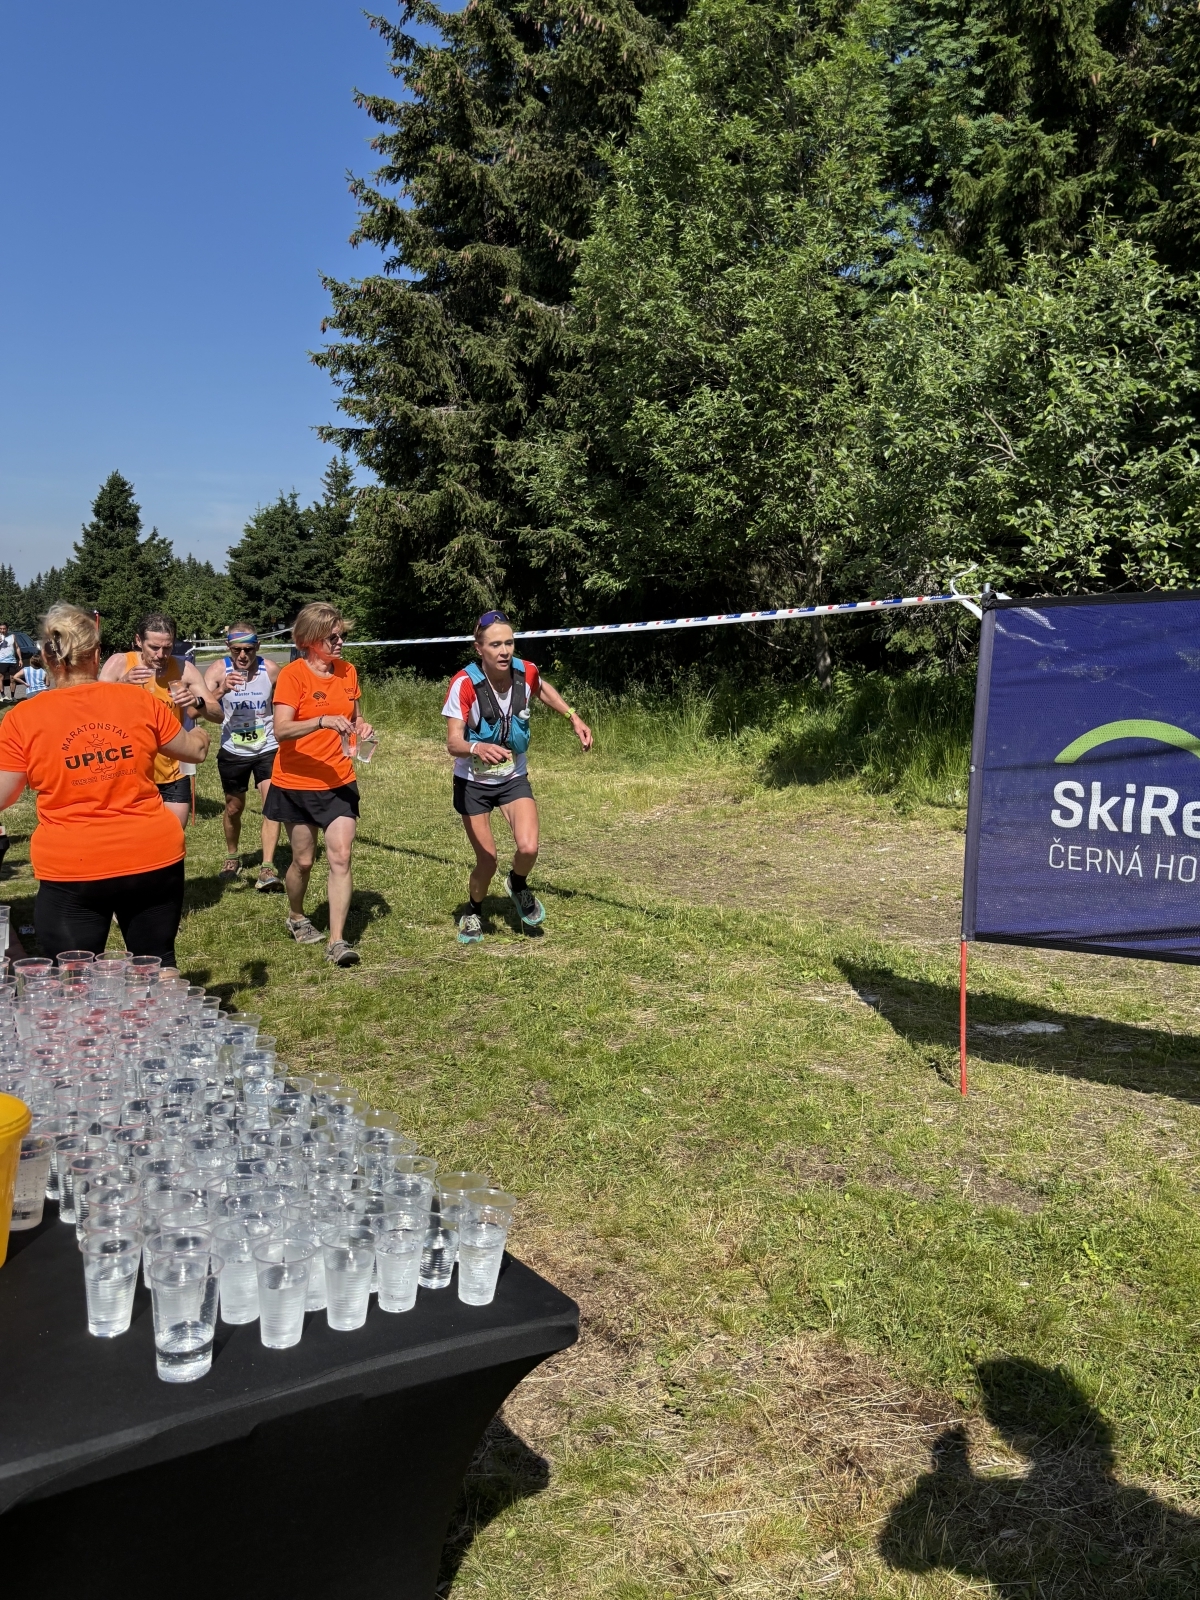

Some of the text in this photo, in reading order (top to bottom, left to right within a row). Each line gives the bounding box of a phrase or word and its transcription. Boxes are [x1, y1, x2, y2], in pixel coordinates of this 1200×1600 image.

[230, 700, 267, 710] ITALIA
[61, 722, 129, 751] MARATONSTAV
[240, 730, 258, 742] 756
[1049, 837, 1197, 882] ČERNÁ HO
